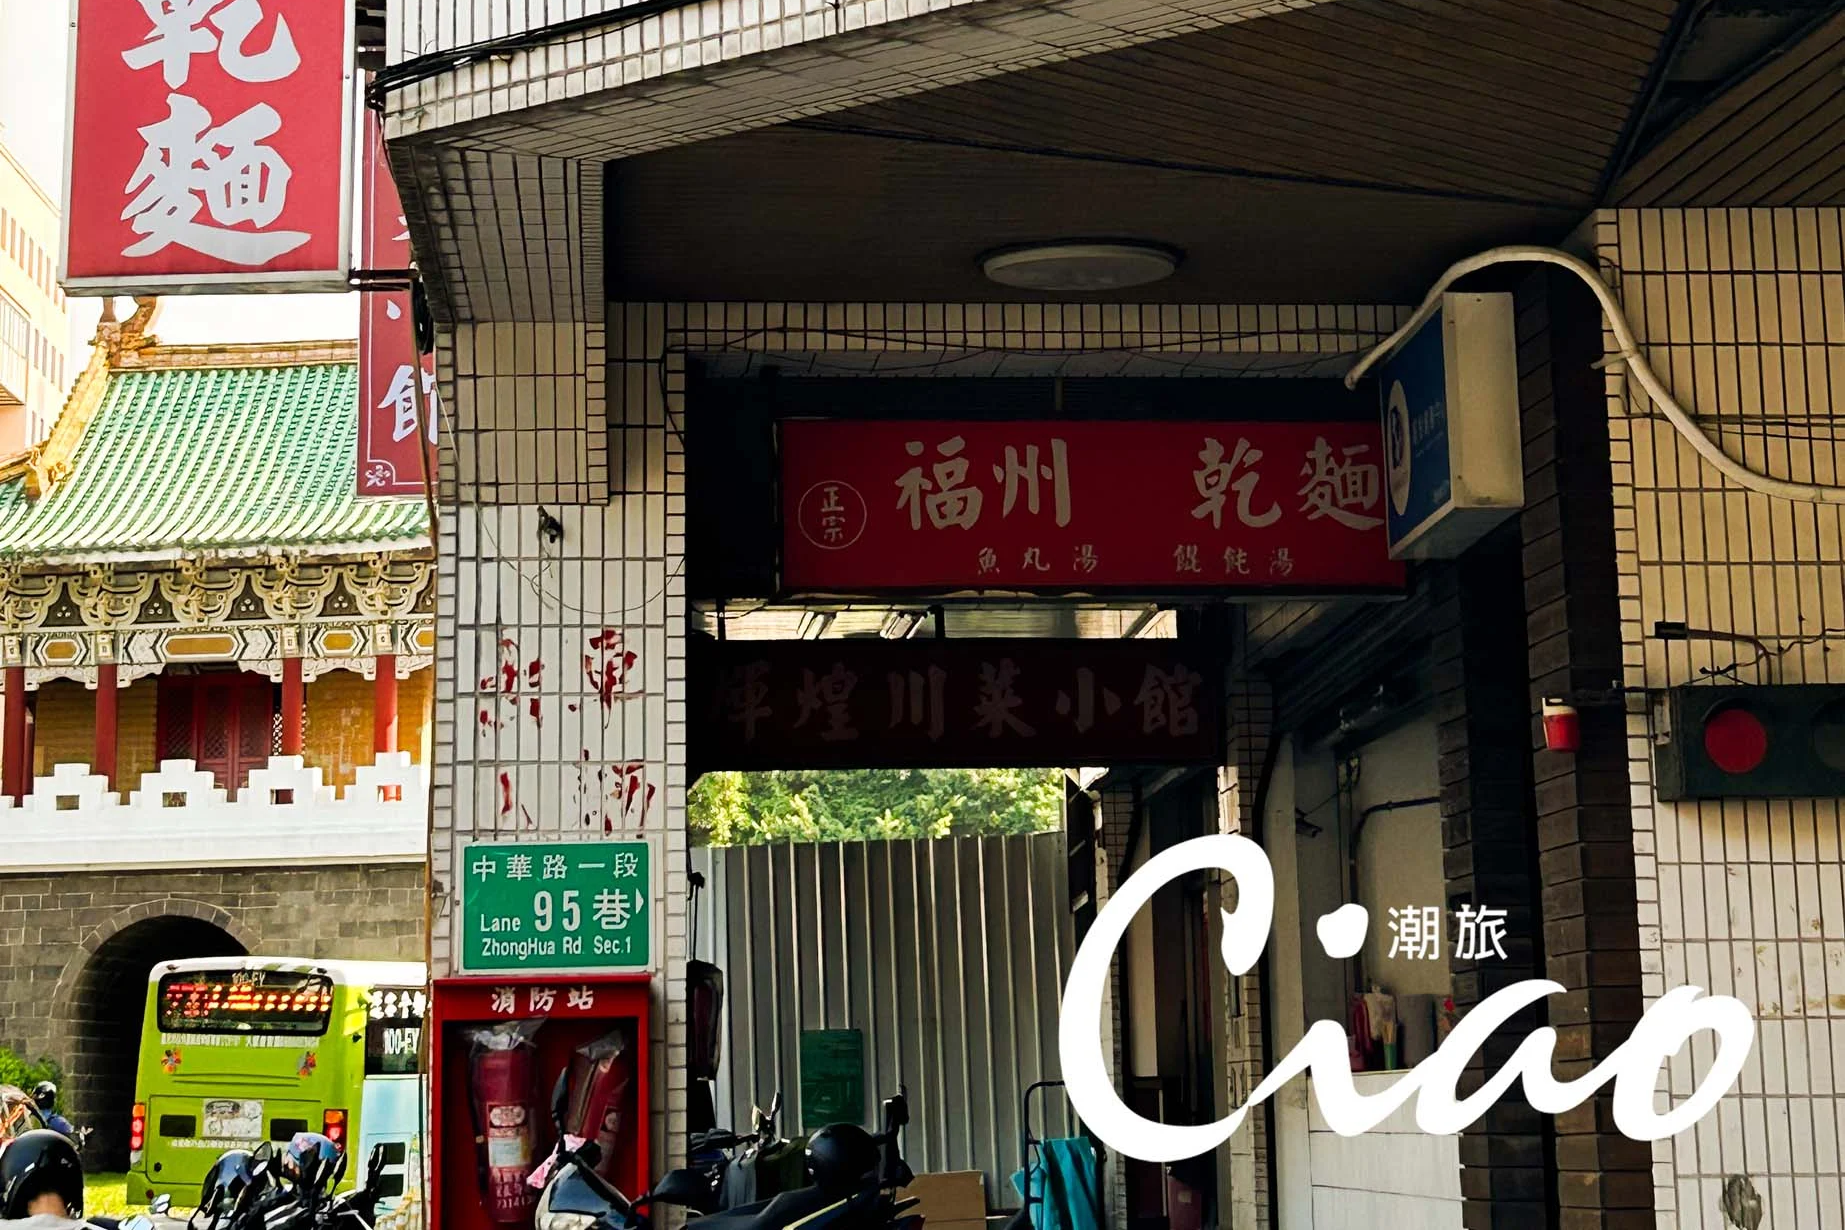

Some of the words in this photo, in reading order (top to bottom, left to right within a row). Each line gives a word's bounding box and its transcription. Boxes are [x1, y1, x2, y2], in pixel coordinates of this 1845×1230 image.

[895, 436, 1071, 531] 福州
[1191, 436, 1385, 531] 乾麵
[820, 486, 846, 543] 正宗
[978, 544, 1100, 576] 魚丸湯
[1173, 544, 1294, 576] 餛飩湯
[472, 852, 638, 881] 中華路一段
[481, 914, 521, 932] Lane
[482, 937, 556, 961] ZhongHua
[491, 985, 594, 1013] 消防站
